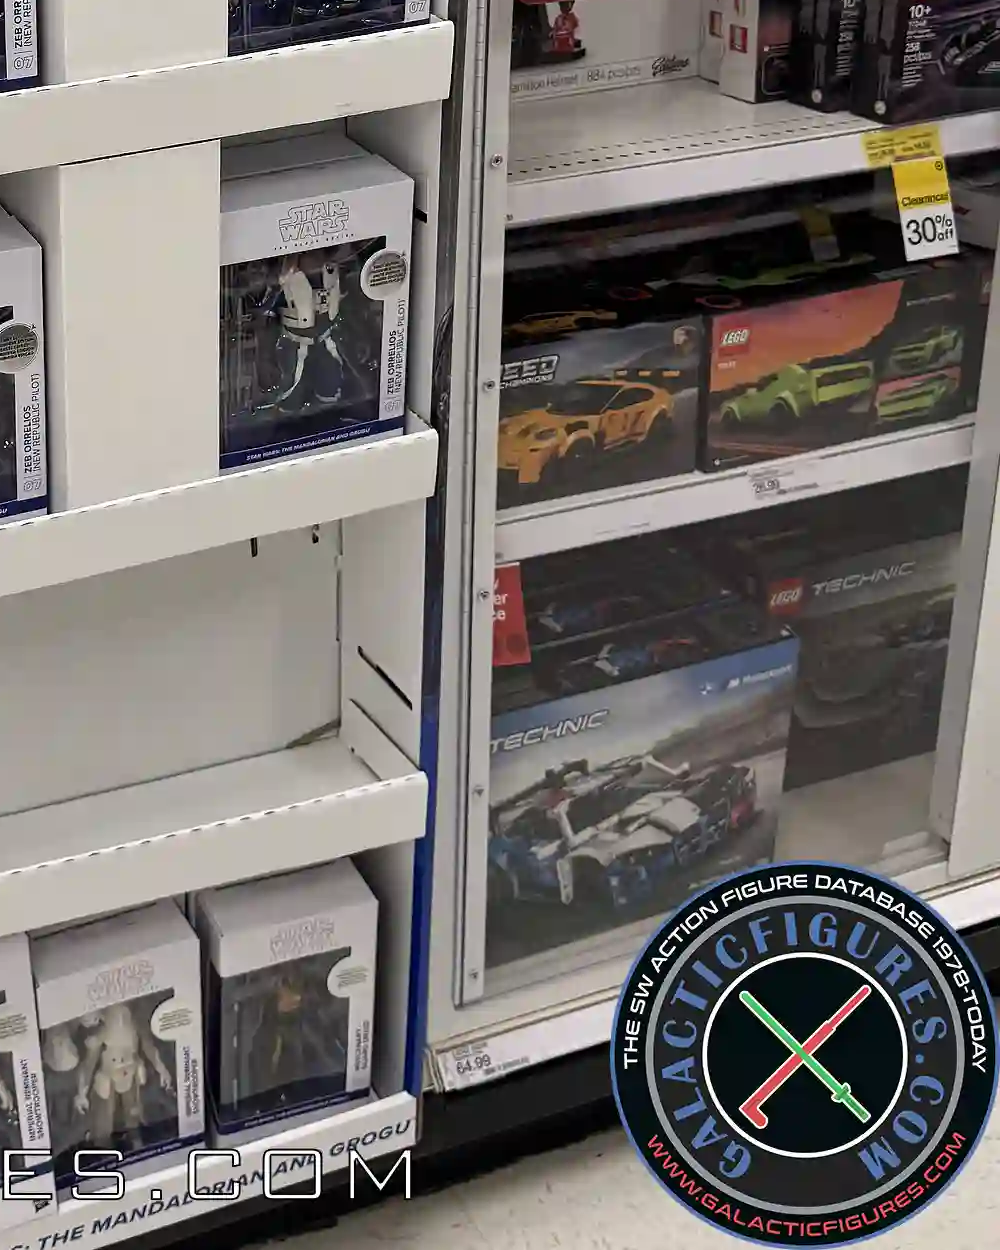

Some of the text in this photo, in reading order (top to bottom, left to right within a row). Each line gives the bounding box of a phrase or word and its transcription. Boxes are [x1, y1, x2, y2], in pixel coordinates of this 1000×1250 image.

[409, 0, 427, 14] 07
[909, 4, 932, 18] 10+
[14, 27, 24, 49] ZEB
[13, 55, 34, 70] 07
[279, 200, 349, 226] STAR
[279, 215, 349, 242] WARS
[937, 228, 953, 241] off
[720, 328, 750, 346] LEGO
[500, 355, 559, 381] EED
[32, 403, 40, 447] REPUBLIC
[23, 406, 33, 473] ZEB ORRELIOS
[770, 561, 916, 607] LEGO TECHNIC
[37, 1225, 85, 1250] THE
[329, 1119, 411, 1157] GROGU
